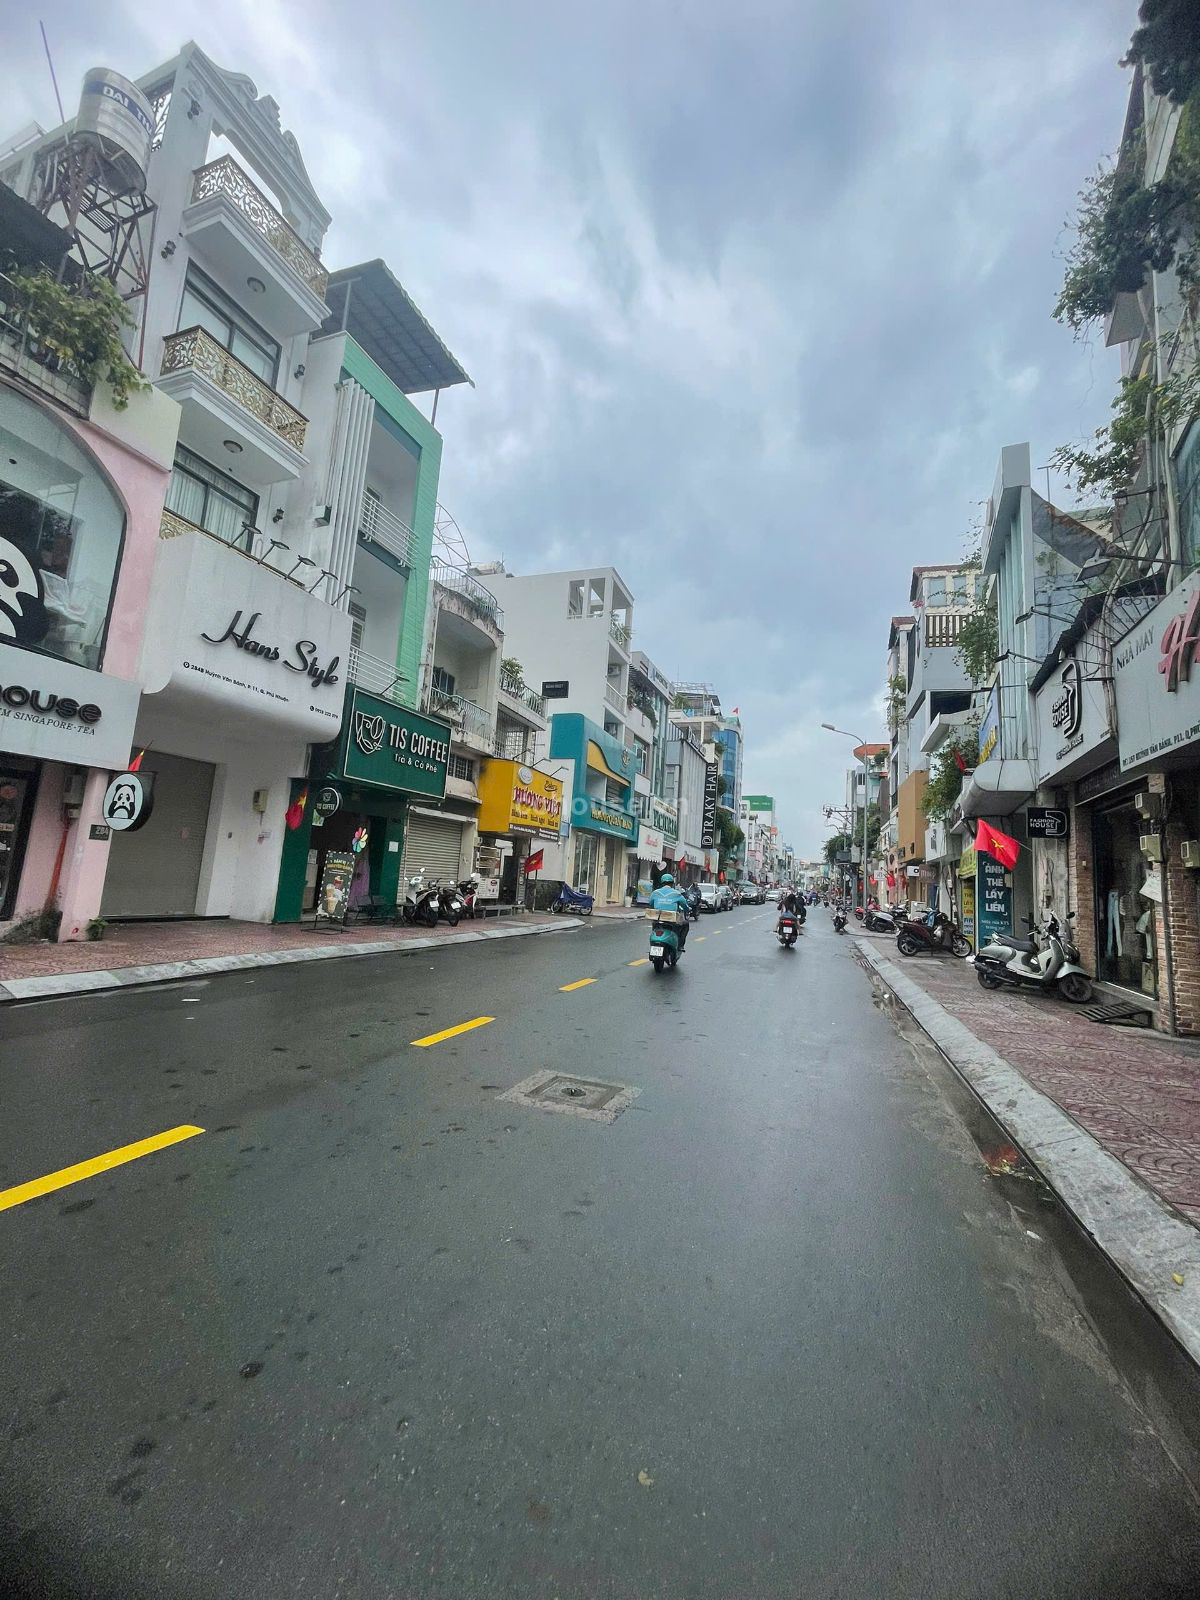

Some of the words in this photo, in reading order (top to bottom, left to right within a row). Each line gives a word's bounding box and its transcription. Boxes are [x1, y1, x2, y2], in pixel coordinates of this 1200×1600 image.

[200, 610, 280, 662] Hans
[283, 640, 340, 688] Style
[0, 684, 102, 724] ouse
[389, 723, 408, 750] TIS
[410, 732, 448, 763] COFFEE
[394, 752, 406, 764] Trà
[407, 757, 413, 766] &
[705, 764, 718, 792] HAIR
[703, 795, 716, 834] TRAKY
